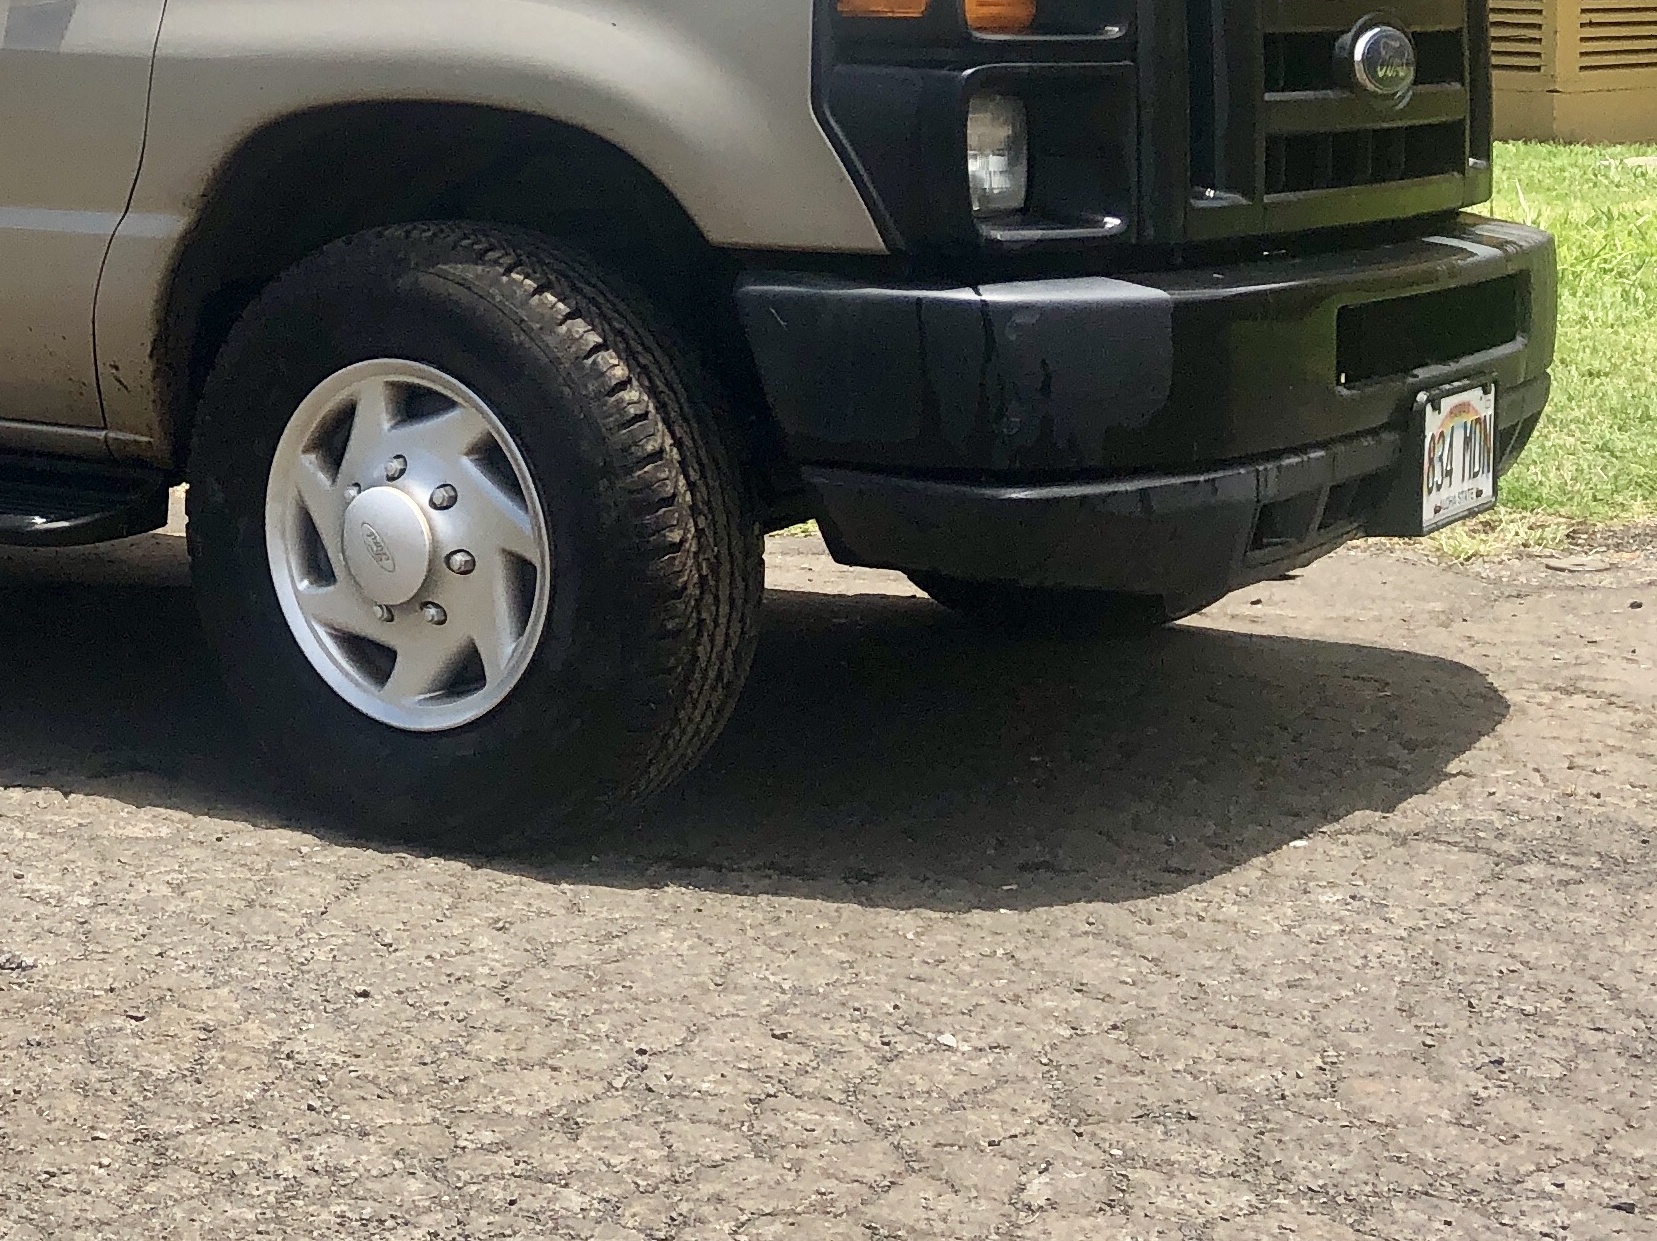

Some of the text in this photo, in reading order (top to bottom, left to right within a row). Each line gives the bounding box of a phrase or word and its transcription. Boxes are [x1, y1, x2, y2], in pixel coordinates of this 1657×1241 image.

[1427, 412, 1493, 496] 834 MDN
[1457, 486, 1475, 506] STATE
